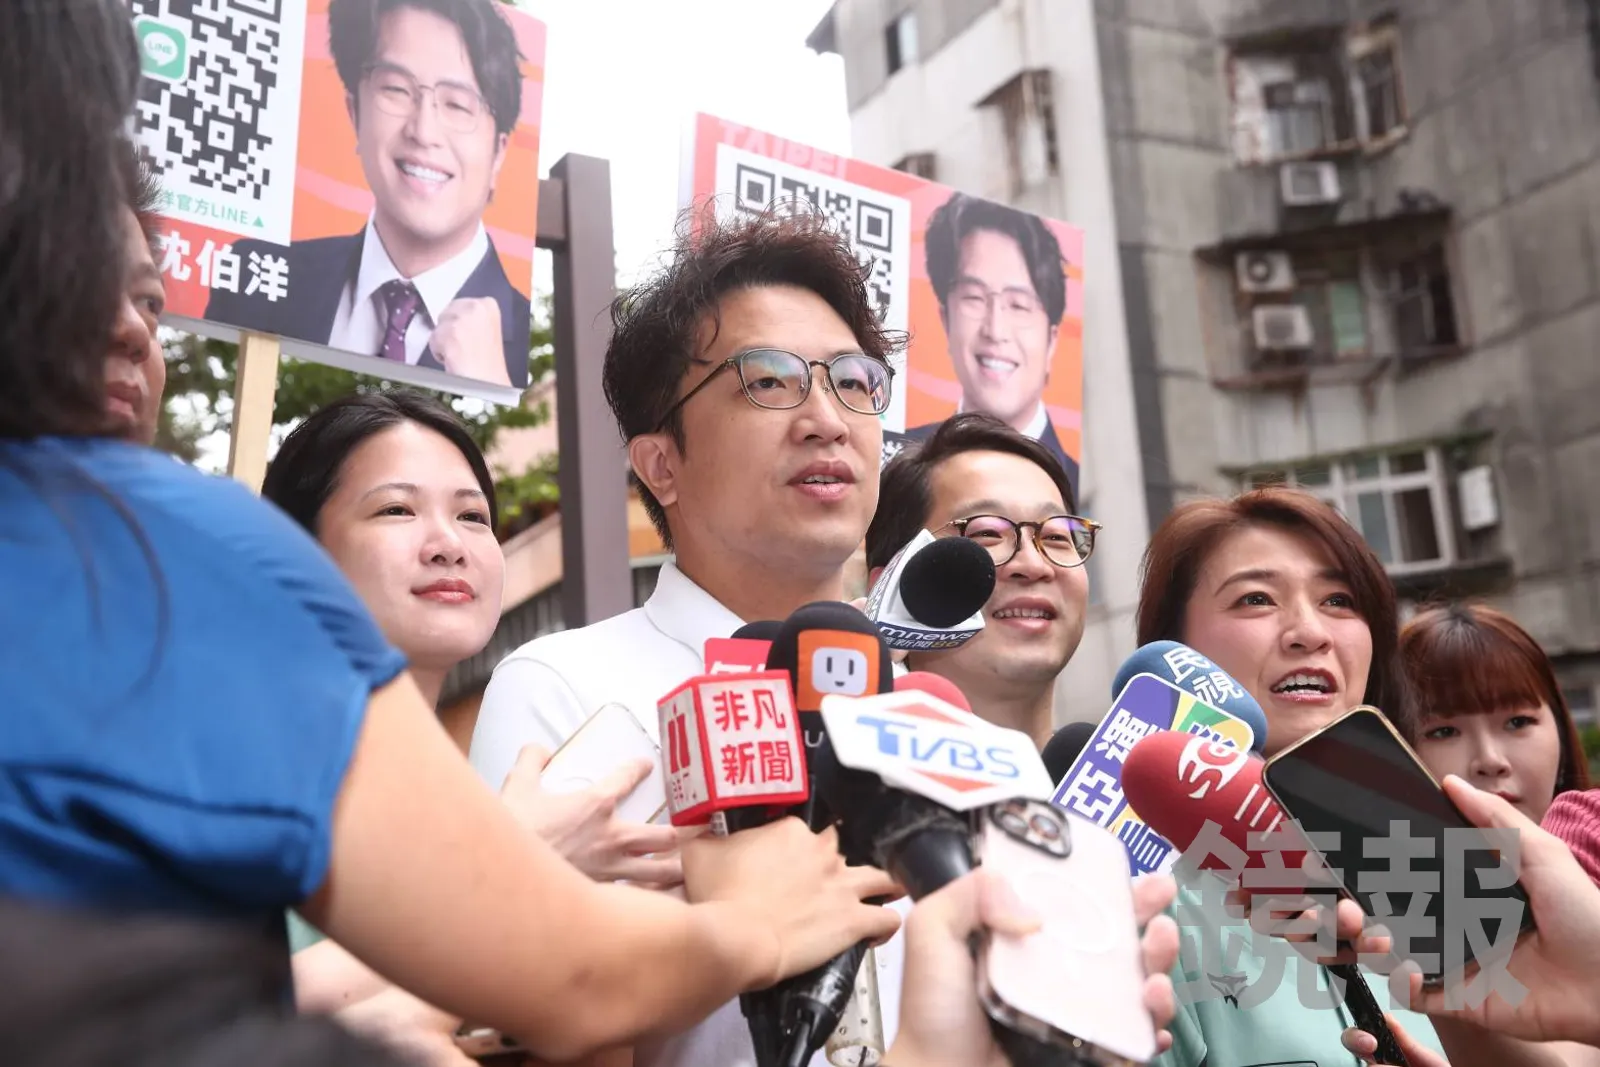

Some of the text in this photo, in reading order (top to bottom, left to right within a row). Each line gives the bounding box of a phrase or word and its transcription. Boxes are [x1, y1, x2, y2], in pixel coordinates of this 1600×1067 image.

[148, 40, 172, 55] LINE
[879, 626, 975, 641] mnews
[1163, 647, 1244, 706] 民視
[712, 689, 787, 731] 非凡
[720, 741, 794, 786] 新聞
[856, 714, 1020, 780] TVBS
